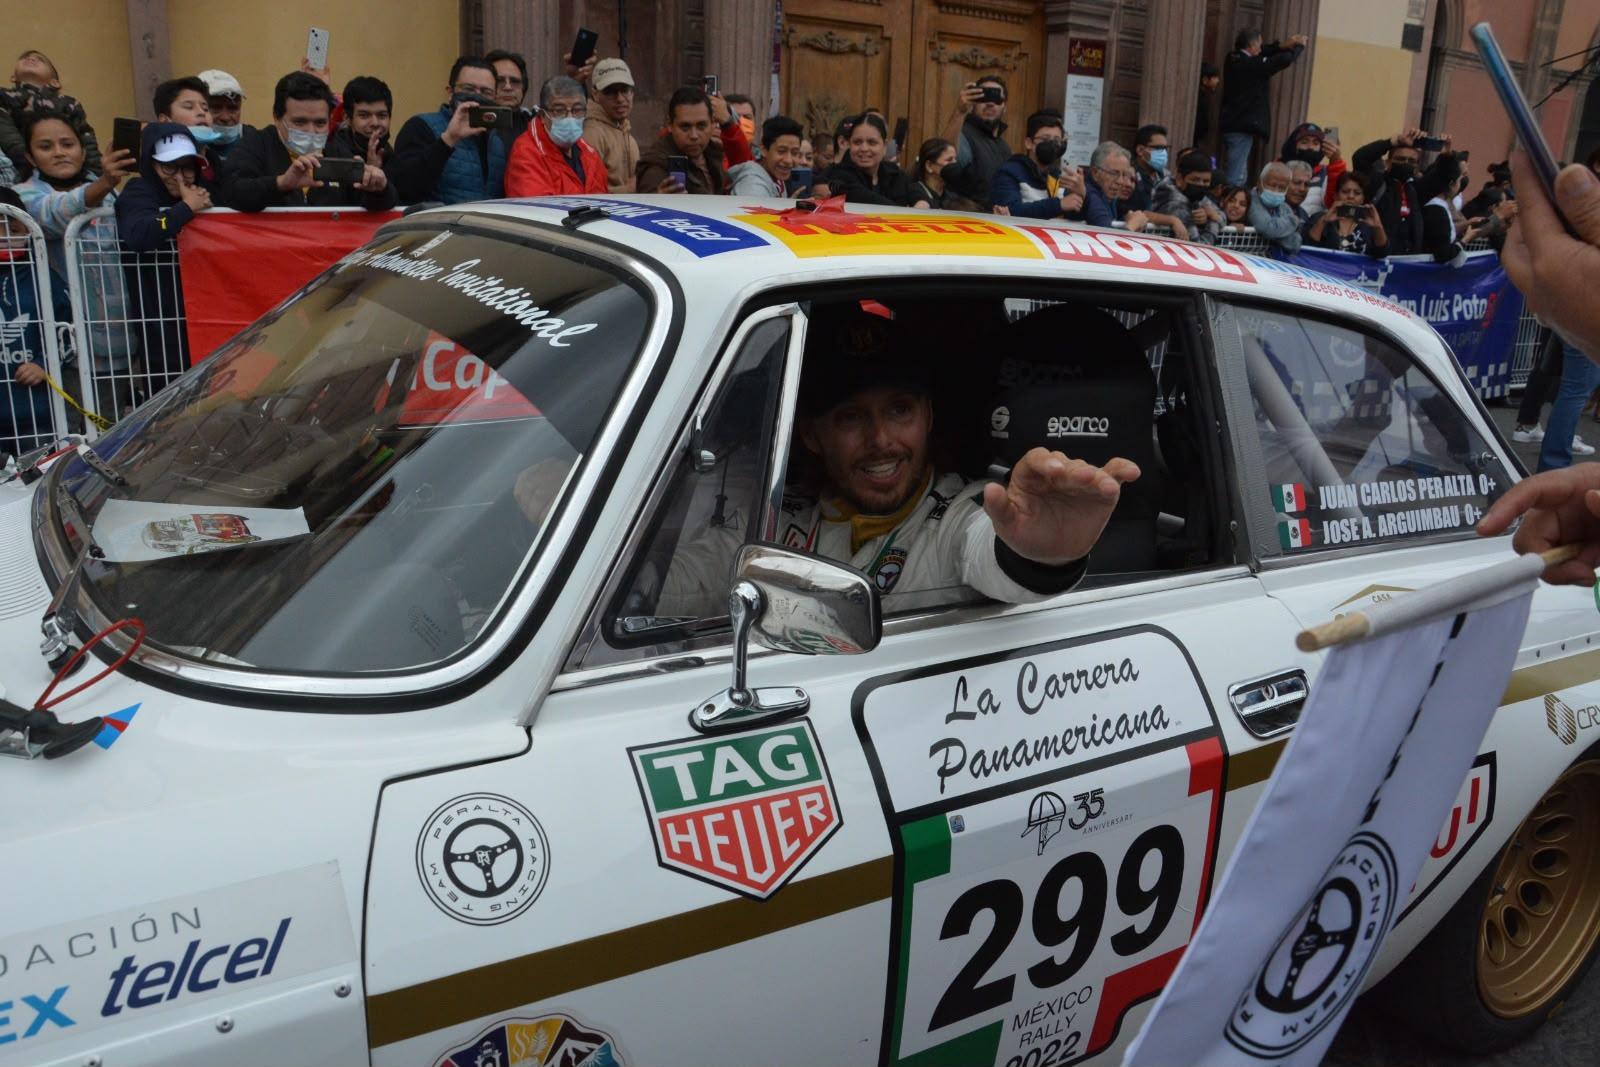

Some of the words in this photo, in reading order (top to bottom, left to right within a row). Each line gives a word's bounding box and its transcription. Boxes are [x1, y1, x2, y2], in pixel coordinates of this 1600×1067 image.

[650, 218, 741, 242] telcel
[1050, 228, 1245, 276] MOTUL
[437, 258, 599, 347] Invitational
[1296, 276, 1343, 297] Exceso
[1421, 292, 1450, 322] Luis
[1047, 416, 1109, 437] sparco
[1319, 484, 1358, 511] JUAN
[1360, 479, 1417, 506] CARLOS
[1418, 474, 1476, 499] PERALTA
[1322, 519, 1360, 545] JOSE
[1362, 514, 1377, 539] A.
[1378, 504, 1460, 537] ARGUIMBAU
[1371, 593, 1393, 605] CASA
[945, 675, 1001, 725] La
[1016, 657, 1140, 716] Carrera
[652, 734, 809, 801] TAG
[929, 703, 1170, 795] Panamericana
[433, 804, 521, 839] PERALTA
[1068, 787, 1105, 830] 35
[1082, 813, 1134, 835] ANNIVERSARY
[666, 791, 828, 884] HEUER
[430, 863, 474, 911] TEAM
[490, 838, 538, 912] RACING
[927, 824, 1185, 1033] 299
[100, 917, 292, 1017] telcel
[1012, 985, 1093, 1032] MÉXICO
[1018, 1012, 1077, 1049] RALLY
